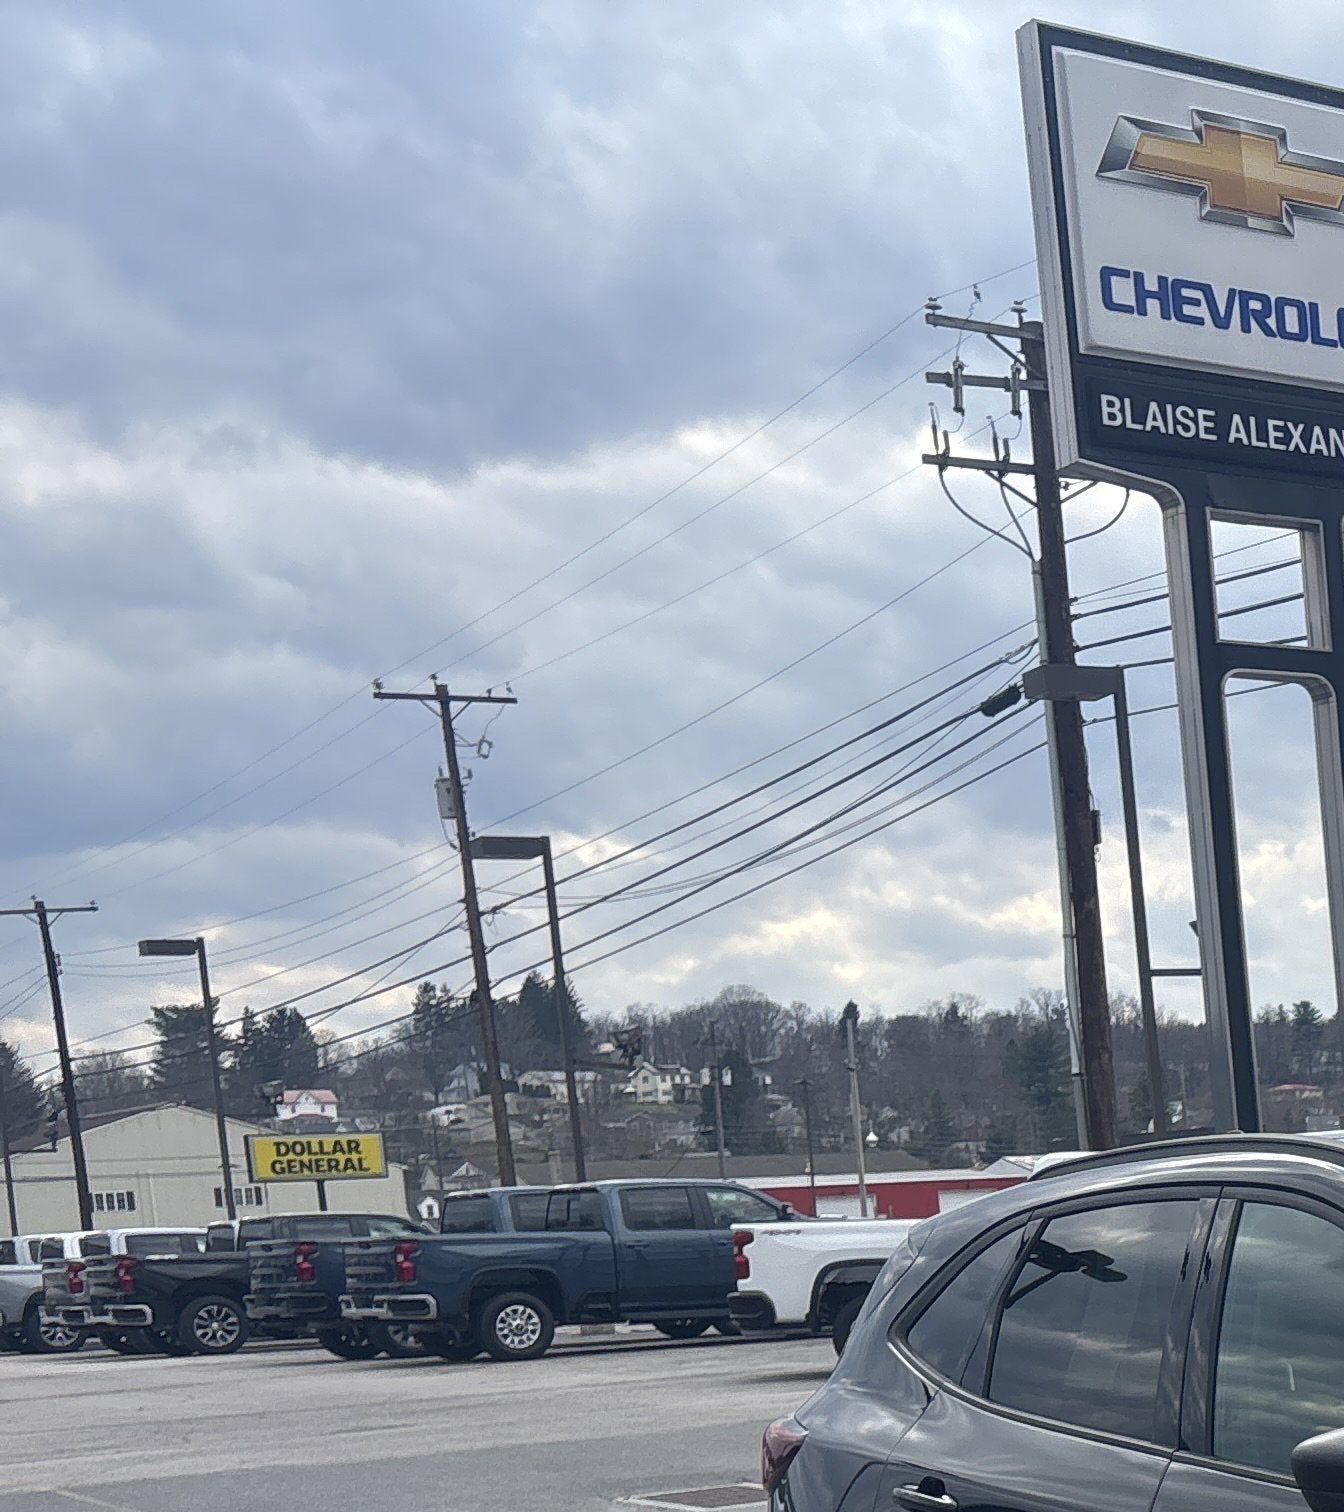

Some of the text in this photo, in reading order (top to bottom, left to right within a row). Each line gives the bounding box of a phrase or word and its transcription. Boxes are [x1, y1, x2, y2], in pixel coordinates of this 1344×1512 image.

[1101, 394, 1217, 442] BLAISE
[273, 1139, 361, 1157] DOLLAR
[270, 1157, 370, 1175] GENERAL
